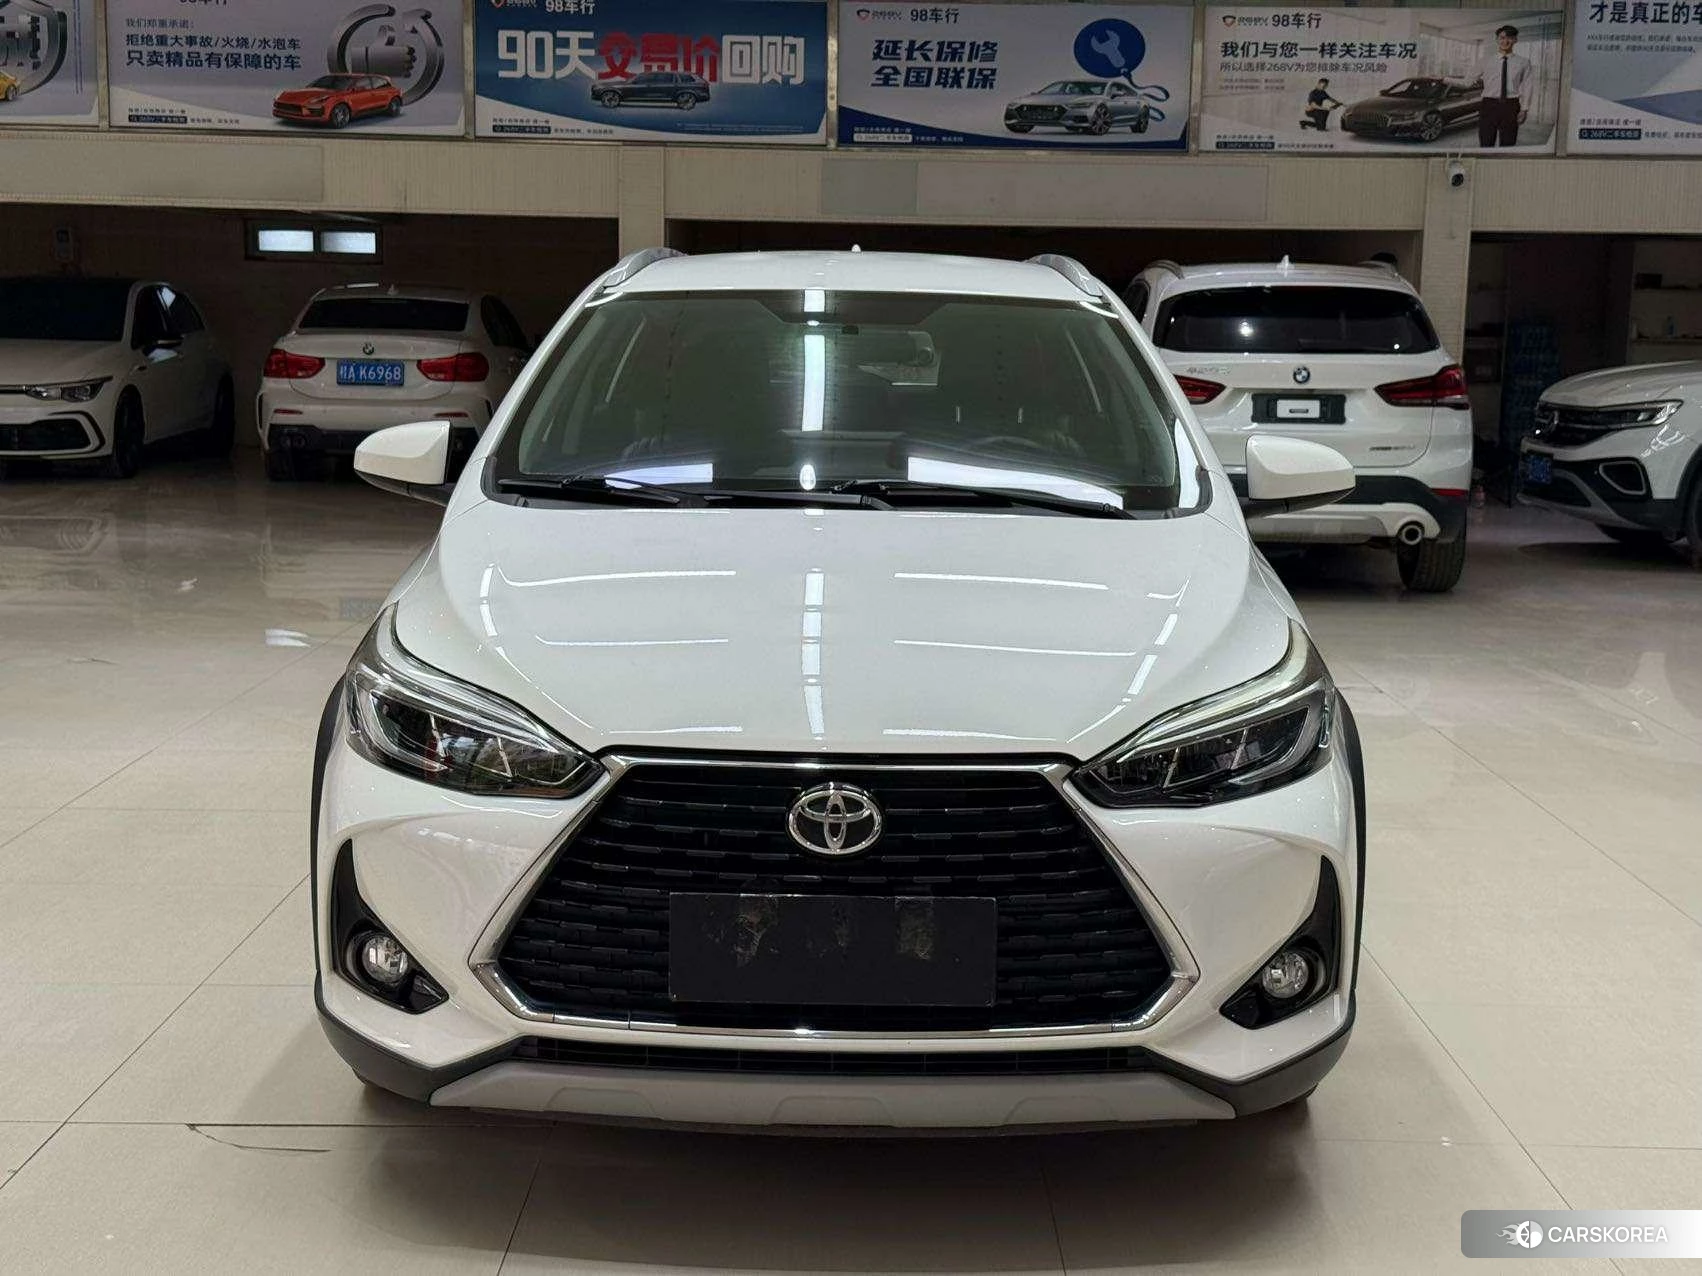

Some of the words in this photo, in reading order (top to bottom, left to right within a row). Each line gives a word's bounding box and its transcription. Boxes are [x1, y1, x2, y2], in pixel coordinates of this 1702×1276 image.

[910, 8, 960, 24] 98车行
[1271, 12, 1322, 29] 98车行
[126, 33, 301, 51] 拒绝重大事故/火烧/水泡车
[871, 39, 999, 63] 延长保修
[1220, 41, 1418, 60] 我们与您一样关注车况
[125, 50, 302, 71] 只卖精品有保障的车
[870, 65, 997, 90] 全国联保
